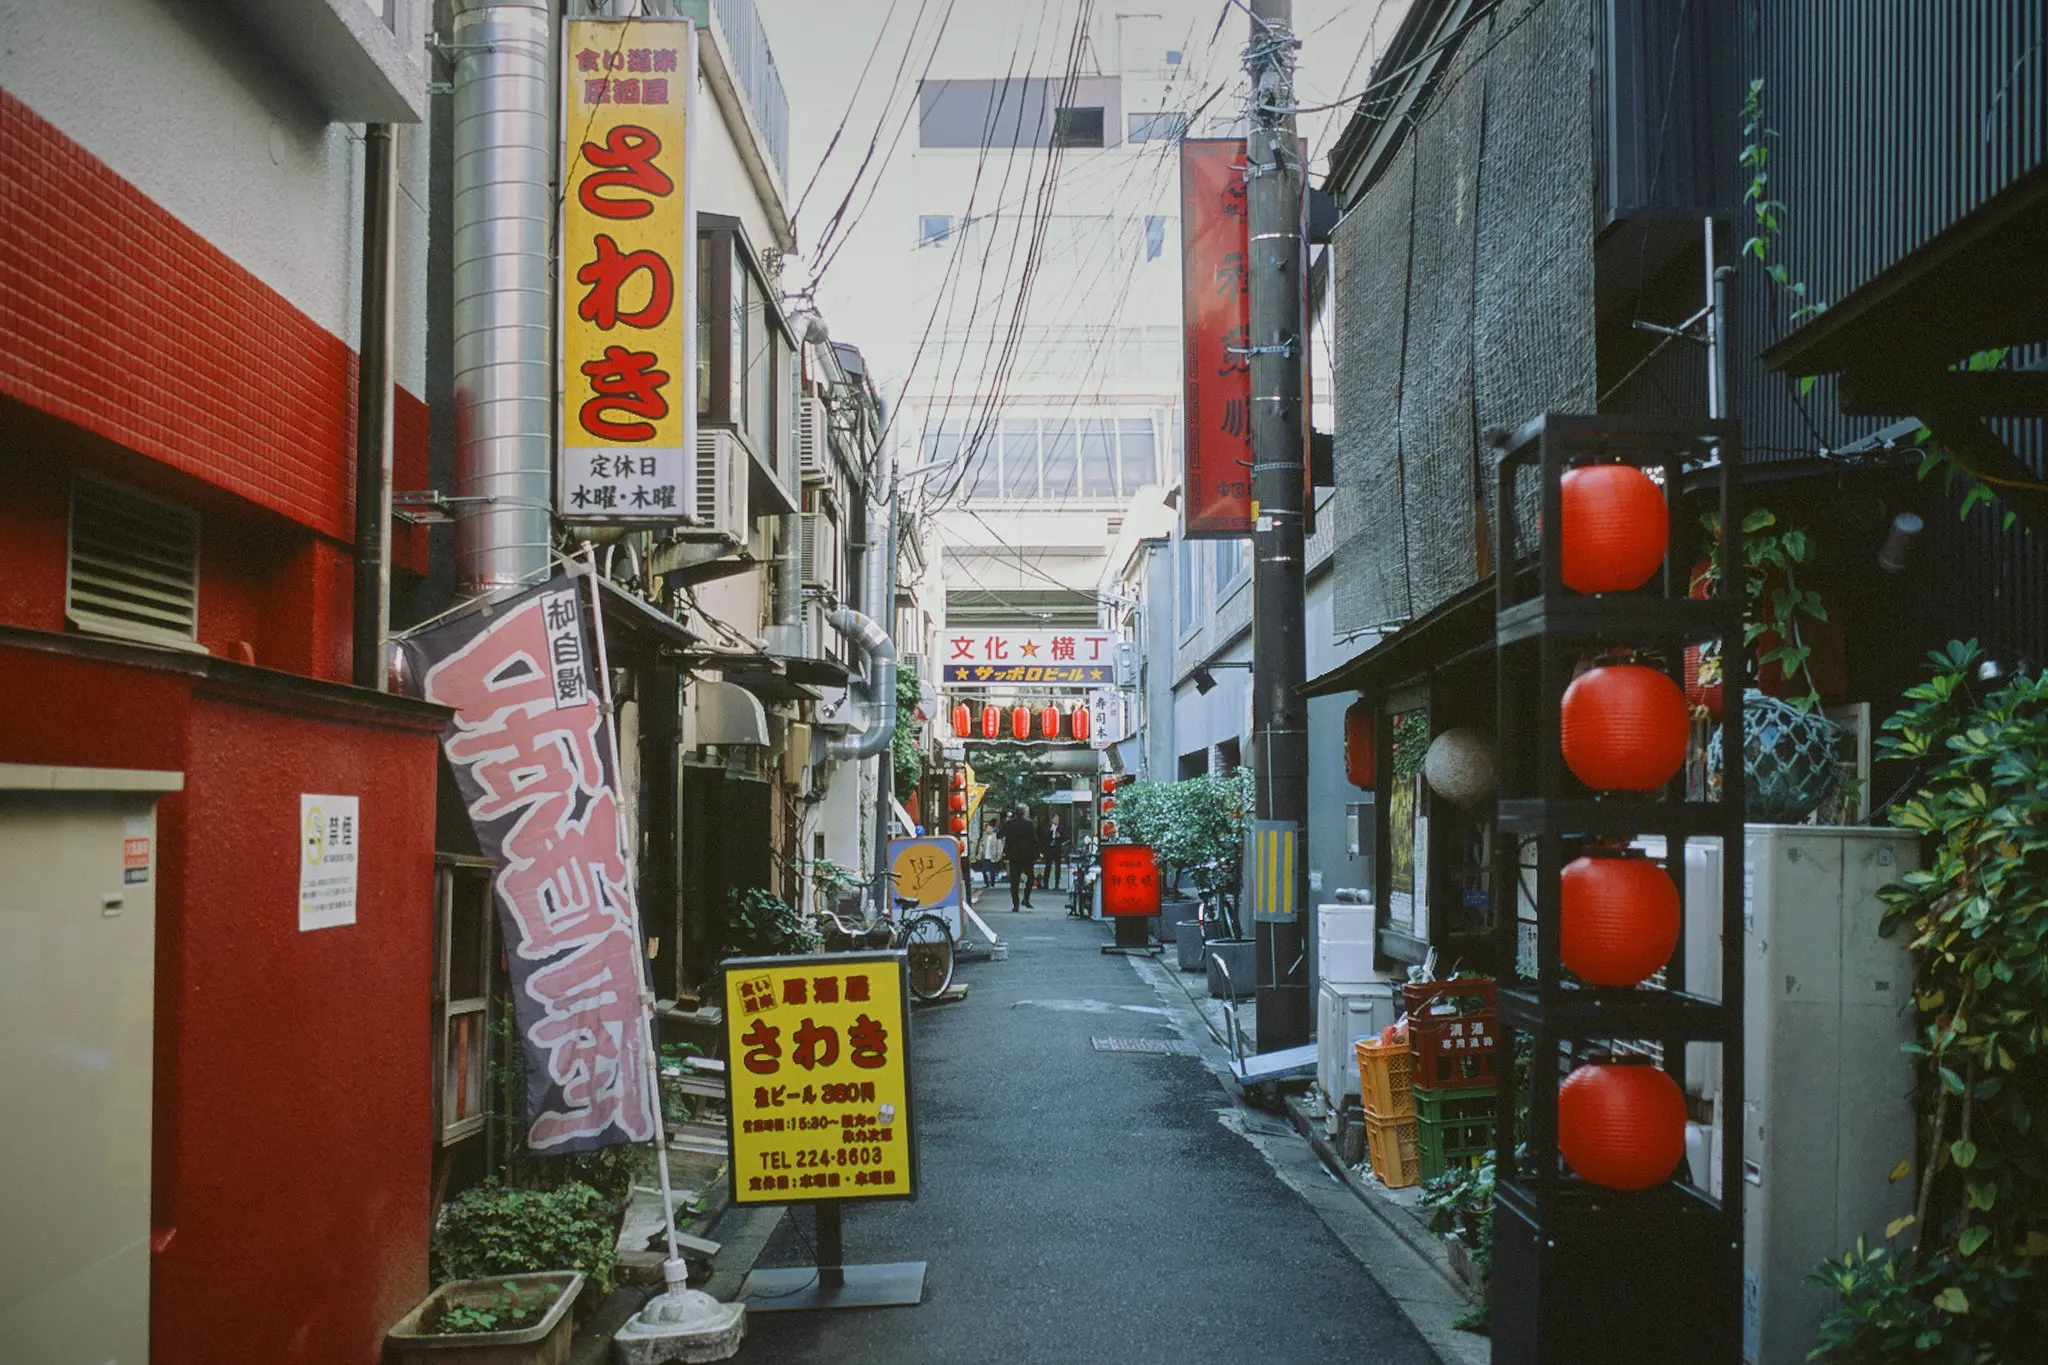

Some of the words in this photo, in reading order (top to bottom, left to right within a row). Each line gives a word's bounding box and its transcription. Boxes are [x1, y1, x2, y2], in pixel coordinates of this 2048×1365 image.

[576, 48, 678, 73] 食い道楽
[584, 78, 669, 104] 居酒屋
[577, 124, 675, 443] さわき
[590, 455, 657, 477] 定休日
[570, 485, 677, 510] 水曜・木曜
[974, 666, 1085, 682] サッポロビール
[782, 975, 870, 1005] 居酒屋
[741, 1014, 888, 1074] さわき
[754, 1084, 817, 1109] 生ビール
[760, 1151, 791, 1170] TEL
